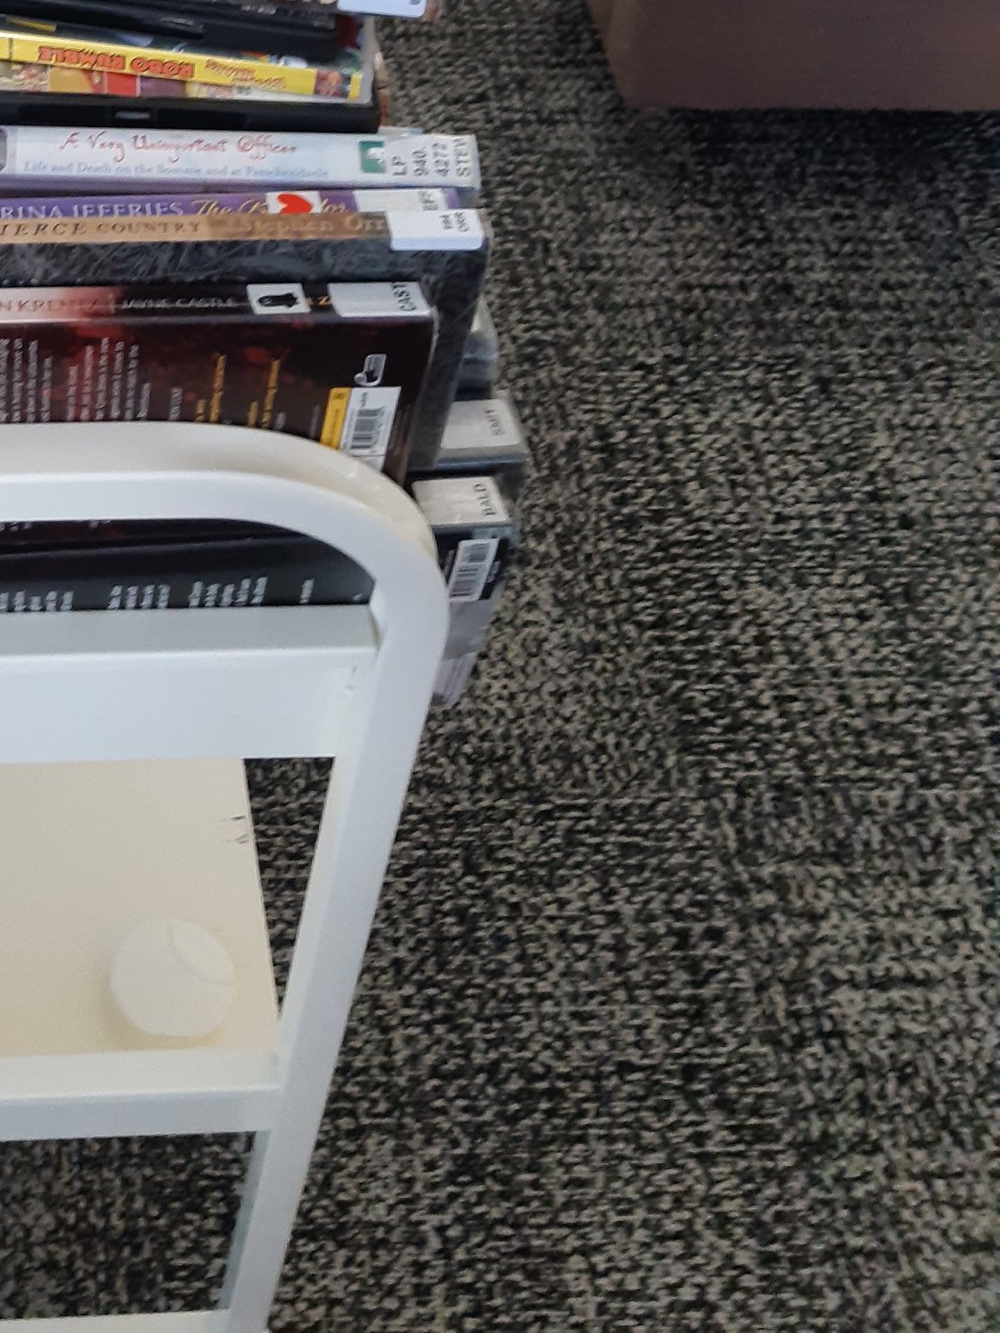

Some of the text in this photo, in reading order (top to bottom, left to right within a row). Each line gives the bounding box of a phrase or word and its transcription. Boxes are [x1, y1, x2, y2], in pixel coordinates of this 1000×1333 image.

[38, 45, 125, 70] RUMBLE
[131, 56, 195, 78] ROBO
[87, 130, 127, 163] Very
[392, 155, 408, 176] LP
[433, 142, 449, 177] 4272
[96, 220, 201, 235] COUNTRY
[391, 281, 416, 312] CAST
